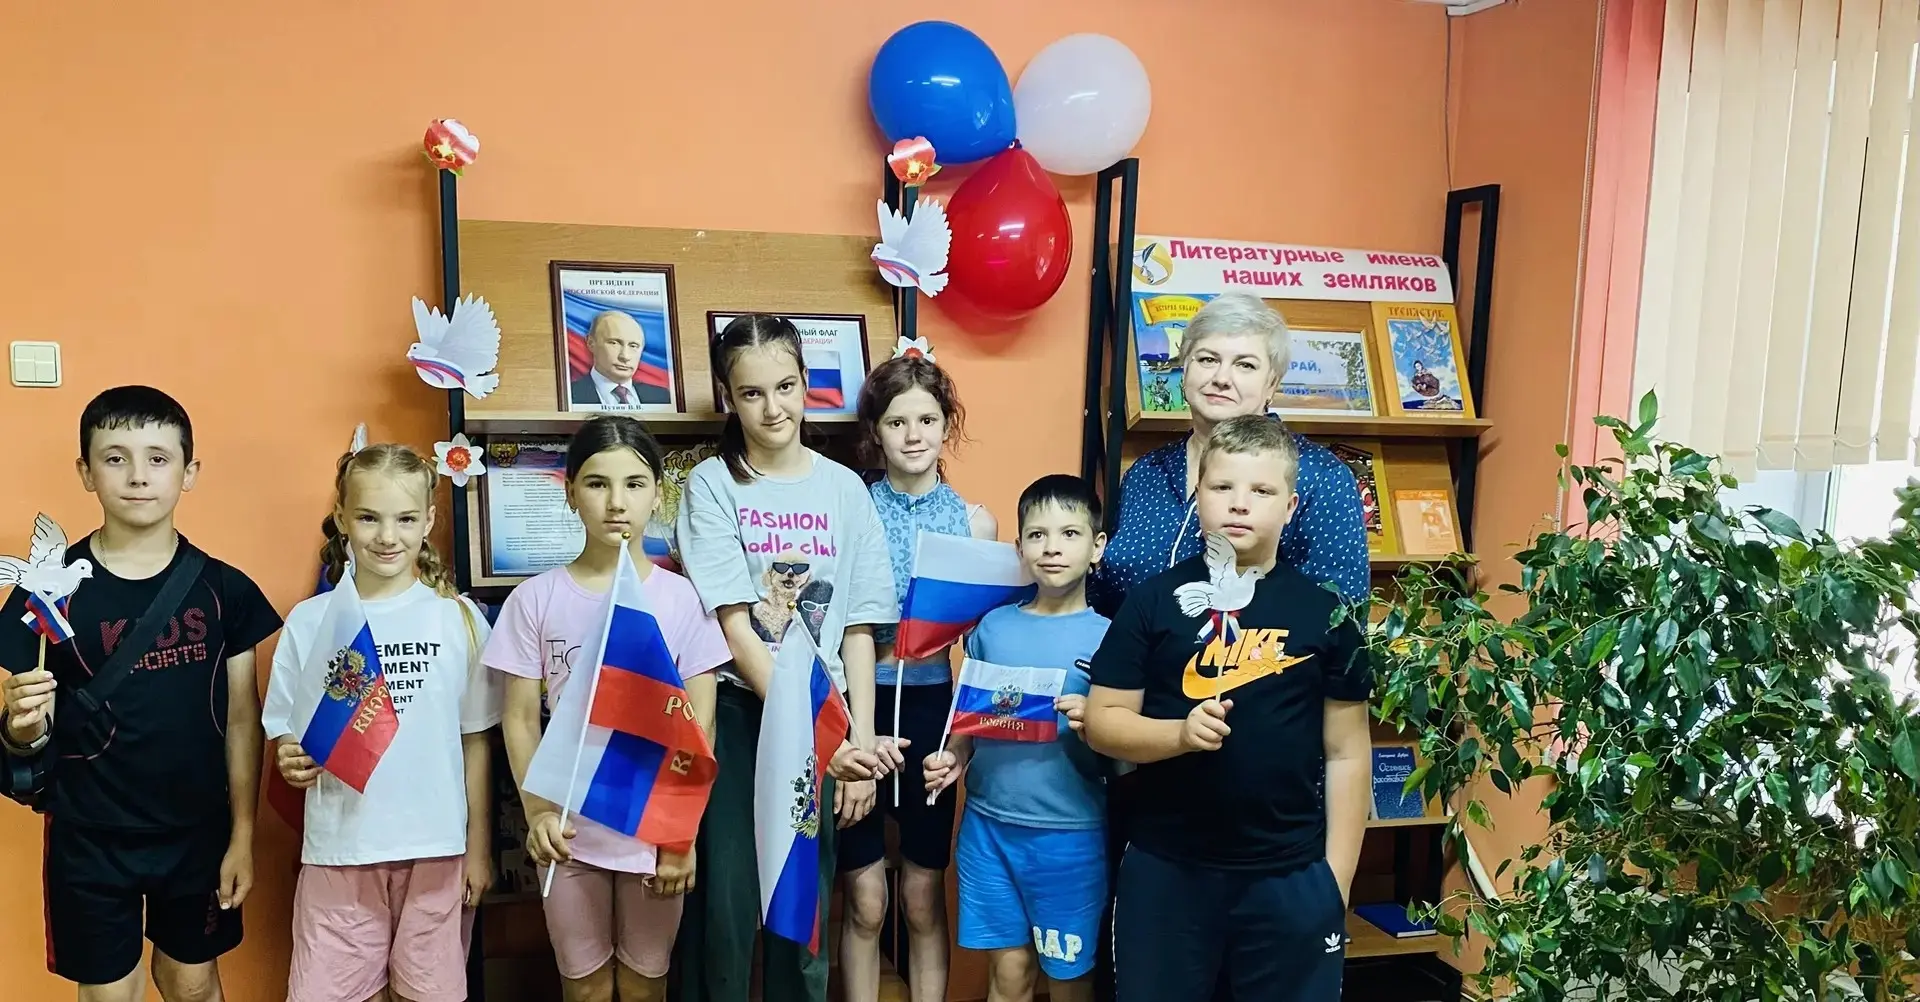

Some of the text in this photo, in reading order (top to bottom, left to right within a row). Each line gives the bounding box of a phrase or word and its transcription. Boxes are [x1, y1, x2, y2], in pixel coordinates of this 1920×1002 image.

[1169, 240, 1441, 268] Литературные имена
[589, 279, 635, 287] ПРЕЗИДЕНТ
[1222, 269, 1437, 292] наших земляков
[567, 288, 660, 297] РОССИЙСКОЙ ФЕДЕРАЦИИ
[799, 327, 817, 336] НЫЙ
[1288, 360, 1321, 374] РАЙ,
[739, 508, 828, 531] FASHION
[746, 532, 837, 557] odle club
[100, 607, 207, 656] KDS
[375, 642, 441, 657] EMENT
[1200, 628, 1289, 667] NIKE
[384, 661, 429, 675] MENT
[385, 679, 424, 690] MENT
[393, 695, 413, 704] ENT
[980, 717, 1024, 731] РОССИЯ
